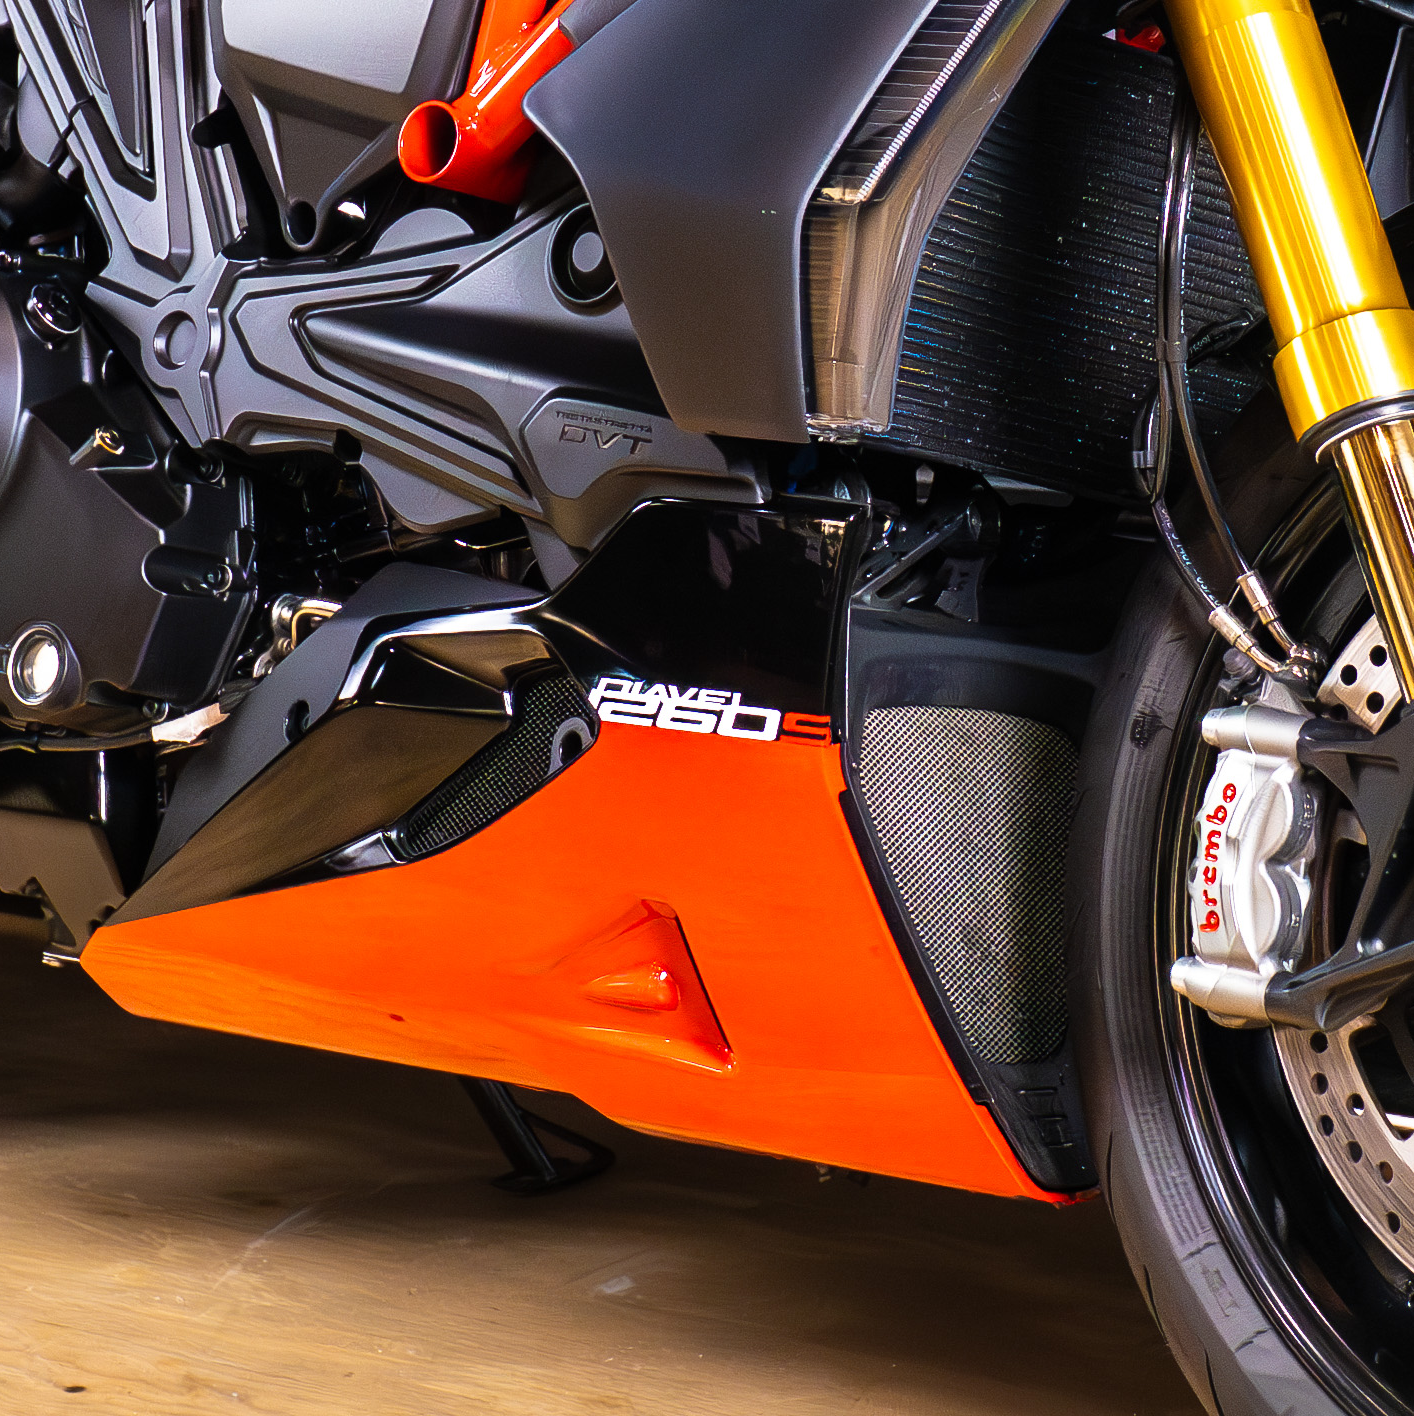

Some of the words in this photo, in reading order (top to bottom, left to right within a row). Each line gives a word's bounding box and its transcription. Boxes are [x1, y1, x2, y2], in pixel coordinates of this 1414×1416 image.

[559, 423, 653, 454] DVT
[595, 677, 742, 707] DIAVEL
[1199, 783, 1237, 933] brembo
